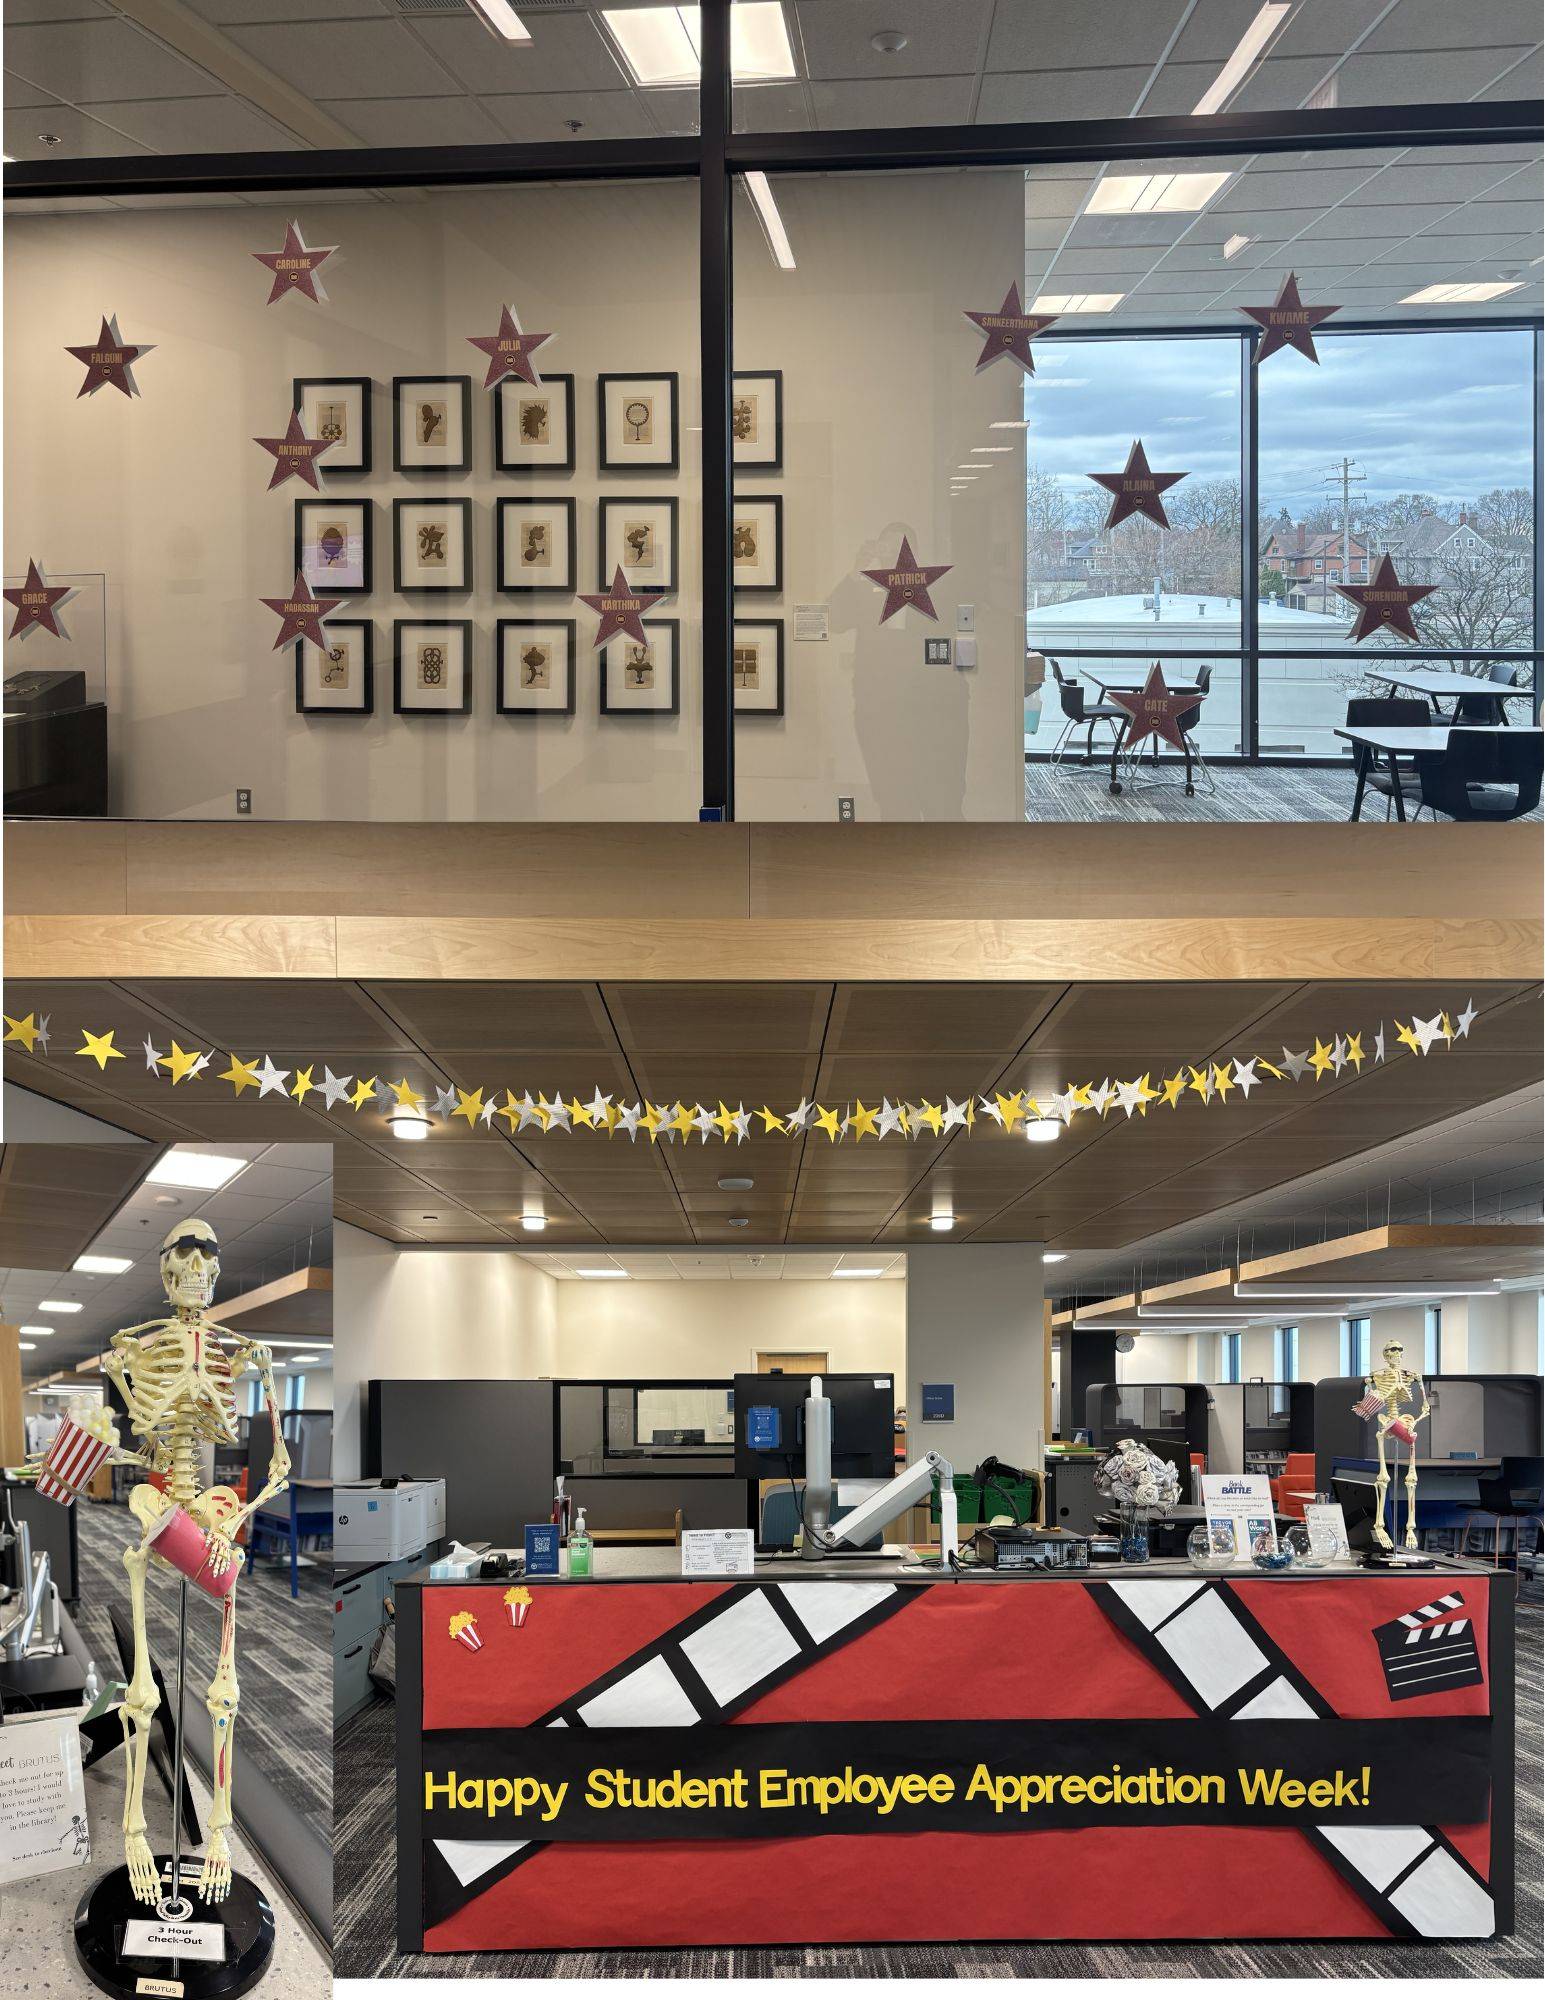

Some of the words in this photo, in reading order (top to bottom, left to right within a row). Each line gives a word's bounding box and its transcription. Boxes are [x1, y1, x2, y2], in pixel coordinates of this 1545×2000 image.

[275, 258, 311, 270] CAROLINE
[981, 316, 1039, 329] SANKEERTHANA
[1269, 311, 1310, 325] KWAME
[497, 339, 521, 351] JULIA
[91, 352, 123, 364] FALGUNI
[278, 445, 313, 456] ANTHONY
[1122, 479, 1156, 491] ALAINA
[888, 572, 927, 586] PATRICK
[22, 592, 48, 605] GRACE
[1362, 591, 1409, 602] SURENDRA
[284, 603, 320, 613] HADASSAH
[601, 599, 641, 611] KARTHIKA
[1144, 699, 1168, 712] CATE
[0, 1756, 15, 1769] eet
[18, 1753, 61, 1769] BRUTUS
[0, 1777, 17, 1786] heck
[42, 1780, 62, 1790] would
[424, 1770, 568, 1822] Happy
[585, 1768, 749, 1809] Student
[759, 1765, 956, 1815] Employee
[965, 1763, 1226, 1813] Appreciation
[1238, 1767, 1371, 1808] Week!
[2, 1801, 16, 1810] love
[27, 1795, 45, 1804] study
[46, 1792, 62, 1801] with
[16, 1807, 37, 1818] Please
[39, 1804, 55, 1816] keep
[18, 1820, 30, 1829] the
[31, 1815, 57, 1827] library!
[168, 1927, 194, 1935] Hour
[147, 1935, 203, 1945] Check-Out
[144, 1984, 178, 1994] BRUTUS
